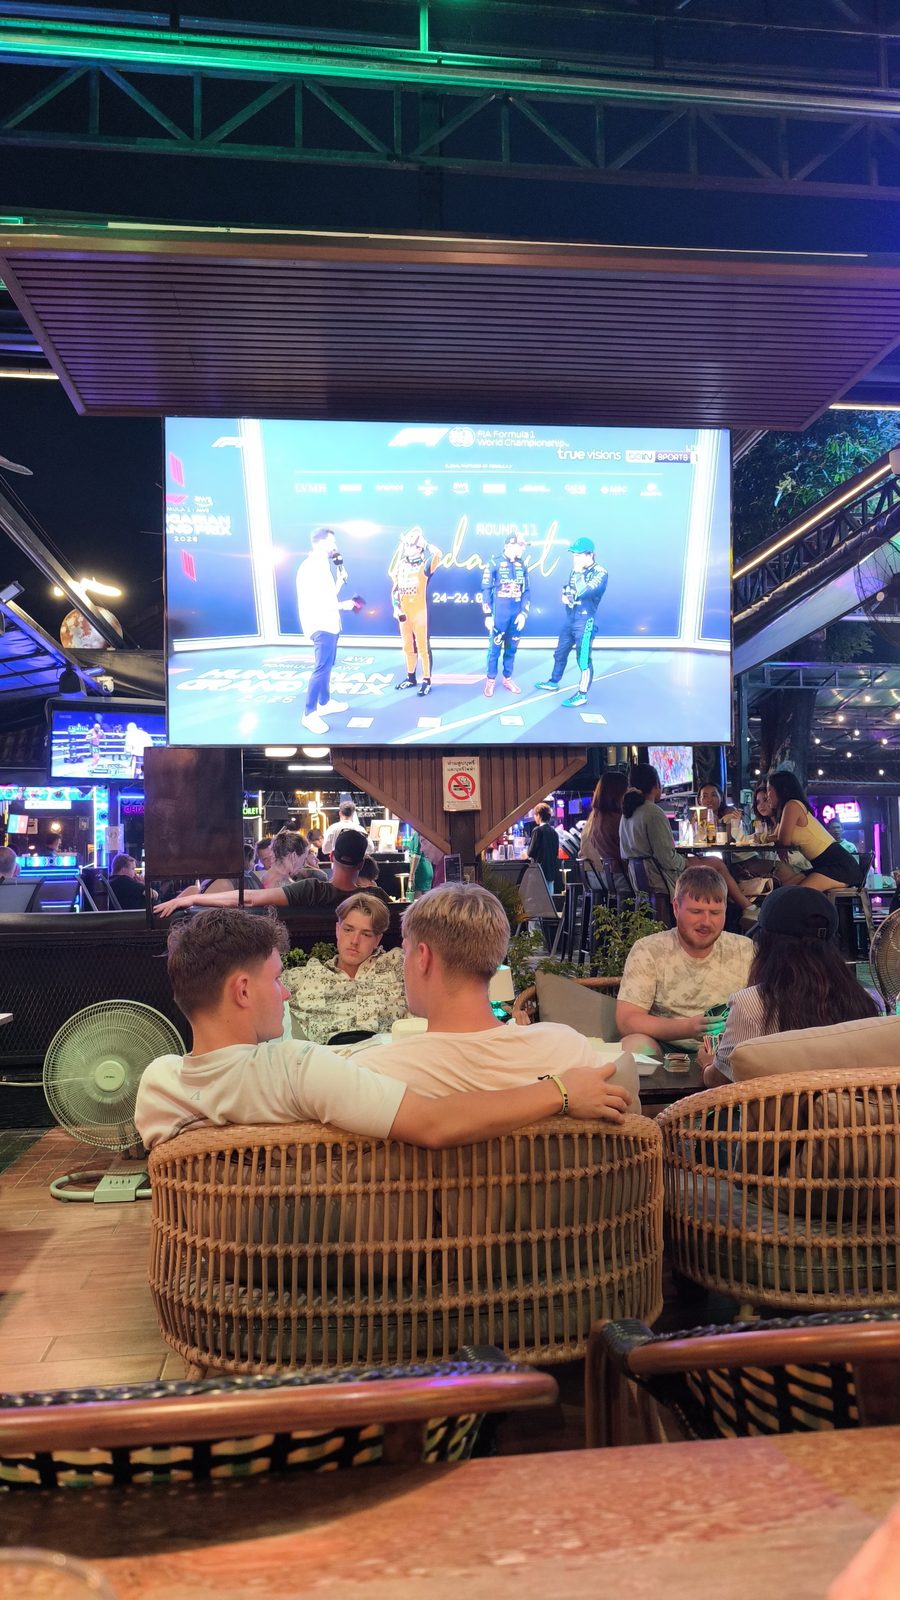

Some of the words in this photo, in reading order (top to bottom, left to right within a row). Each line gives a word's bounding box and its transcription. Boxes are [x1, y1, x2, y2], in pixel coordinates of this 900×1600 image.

[494, 430, 529, 438] Formula
[478, 438, 503, 447] World
[504, 438, 564, 448] Championship
[557, 448, 585, 460] true
[587, 449, 621, 460] visions
[657, 453, 688, 462] SPORTS
[432, 592, 483, 604] 24-26.0
[242, 807, 259, 815] OILET
